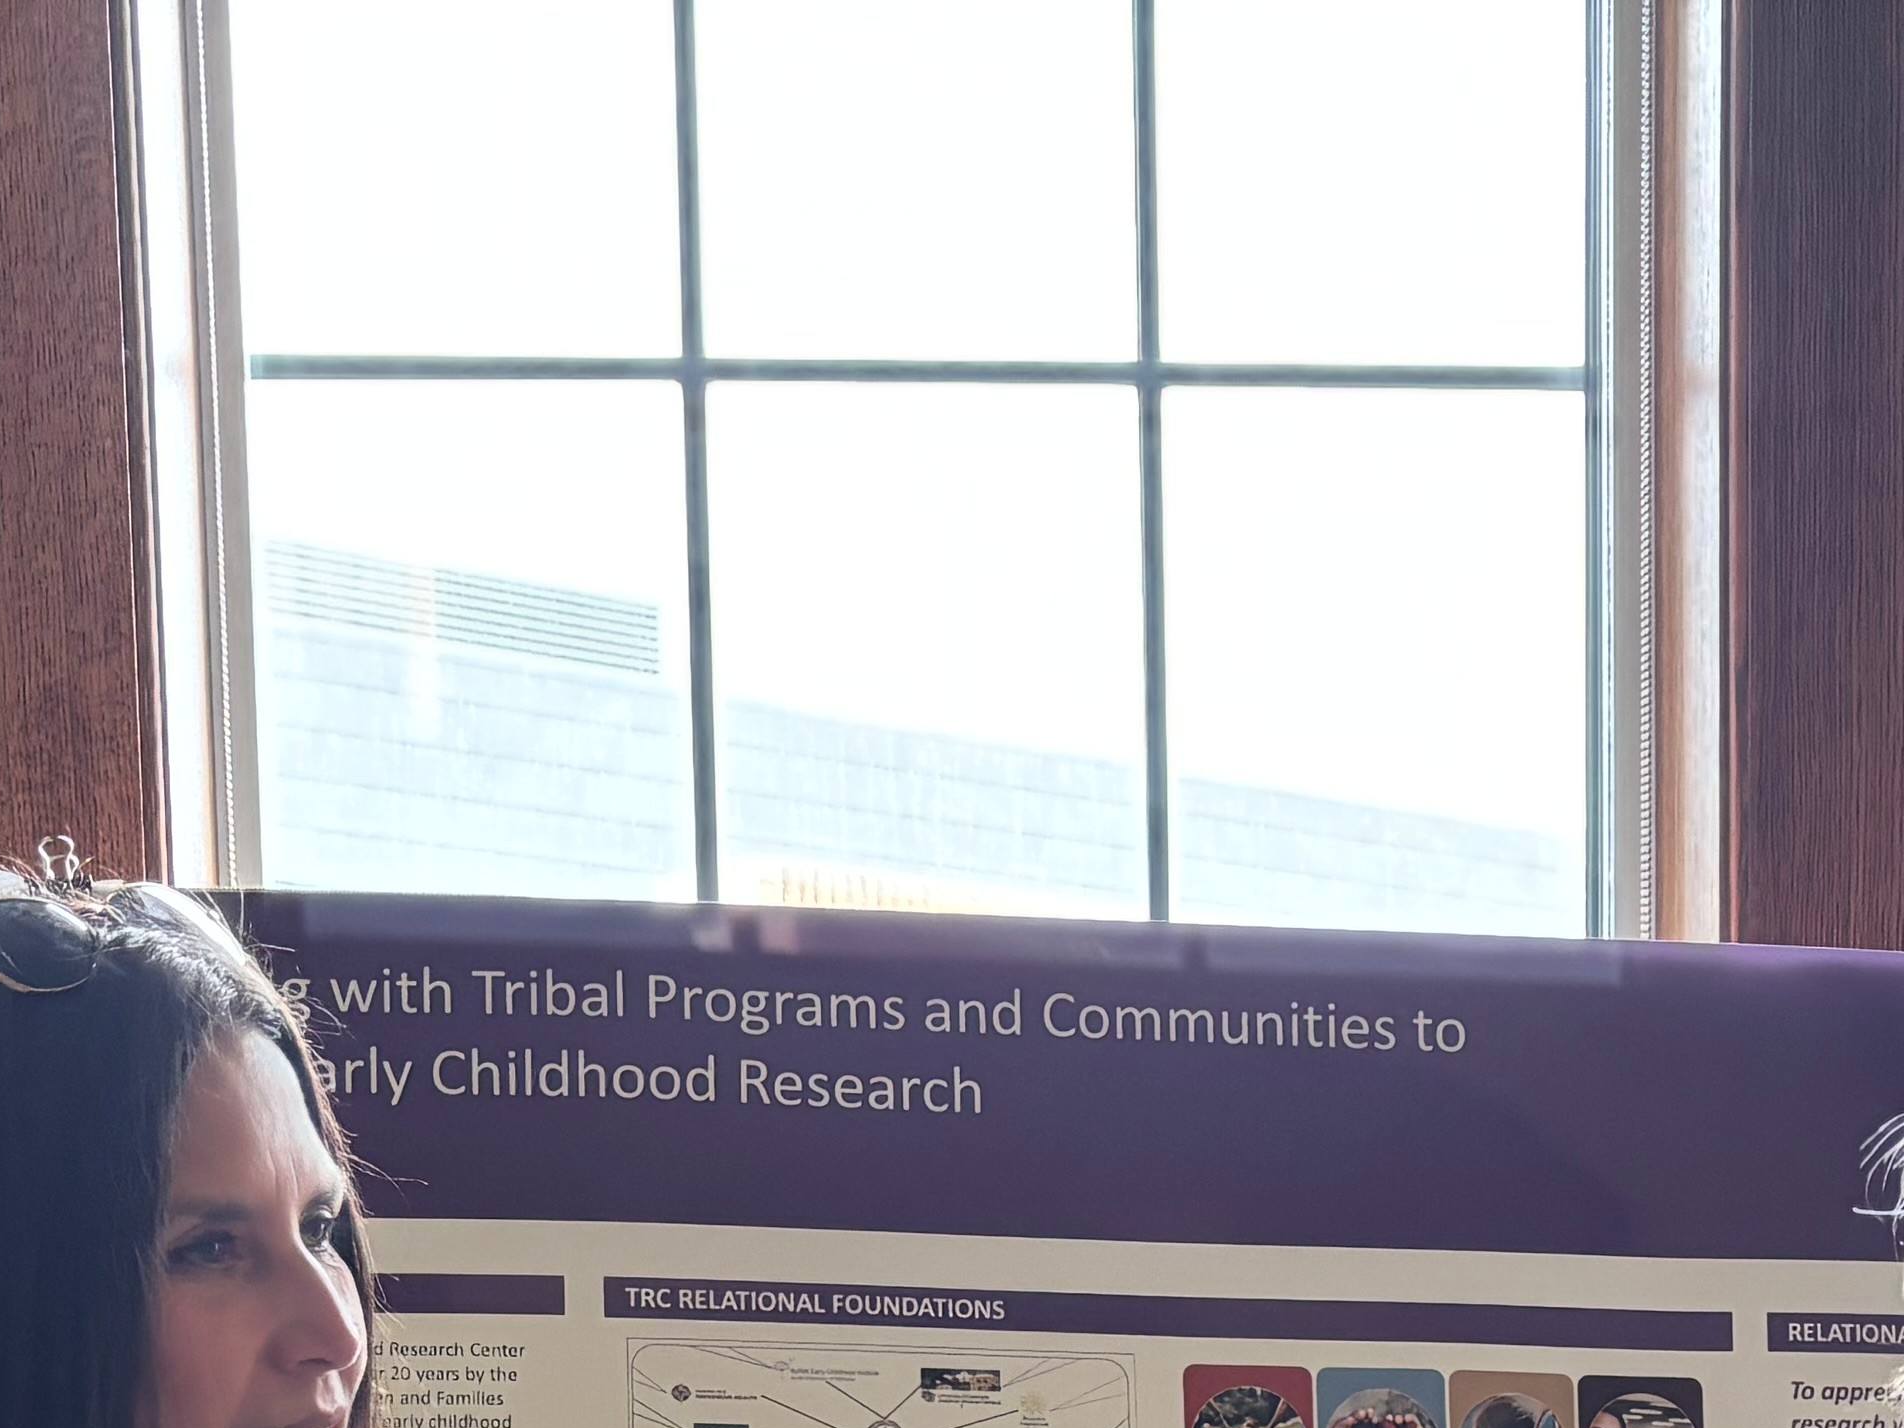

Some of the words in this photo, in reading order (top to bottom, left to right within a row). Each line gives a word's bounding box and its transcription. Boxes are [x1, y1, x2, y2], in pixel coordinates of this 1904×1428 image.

[330, 966, 452, 1014] with
[472, 968, 623, 1017] Tribal
[649, 974, 905, 1035] Programs
[925, 987, 1021, 1035] and
[1044, 993, 1396, 1050] Communities
[1412, 1009, 1465, 1053] to
[315, 1046, 412, 1105] arly
[433, 1048, 715, 1102] Childhood
[741, 1059, 981, 1113] Research
[625, 1287, 671, 1308] TRC
[679, 1289, 825, 1313] RELATIONAL
[833, 1294, 1005, 1320] FOUNDATIONS
[390, 1342, 464, 1357] Research
[470, 1343, 525, 1358] Center
[1791, 1381, 1815, 1401] To
